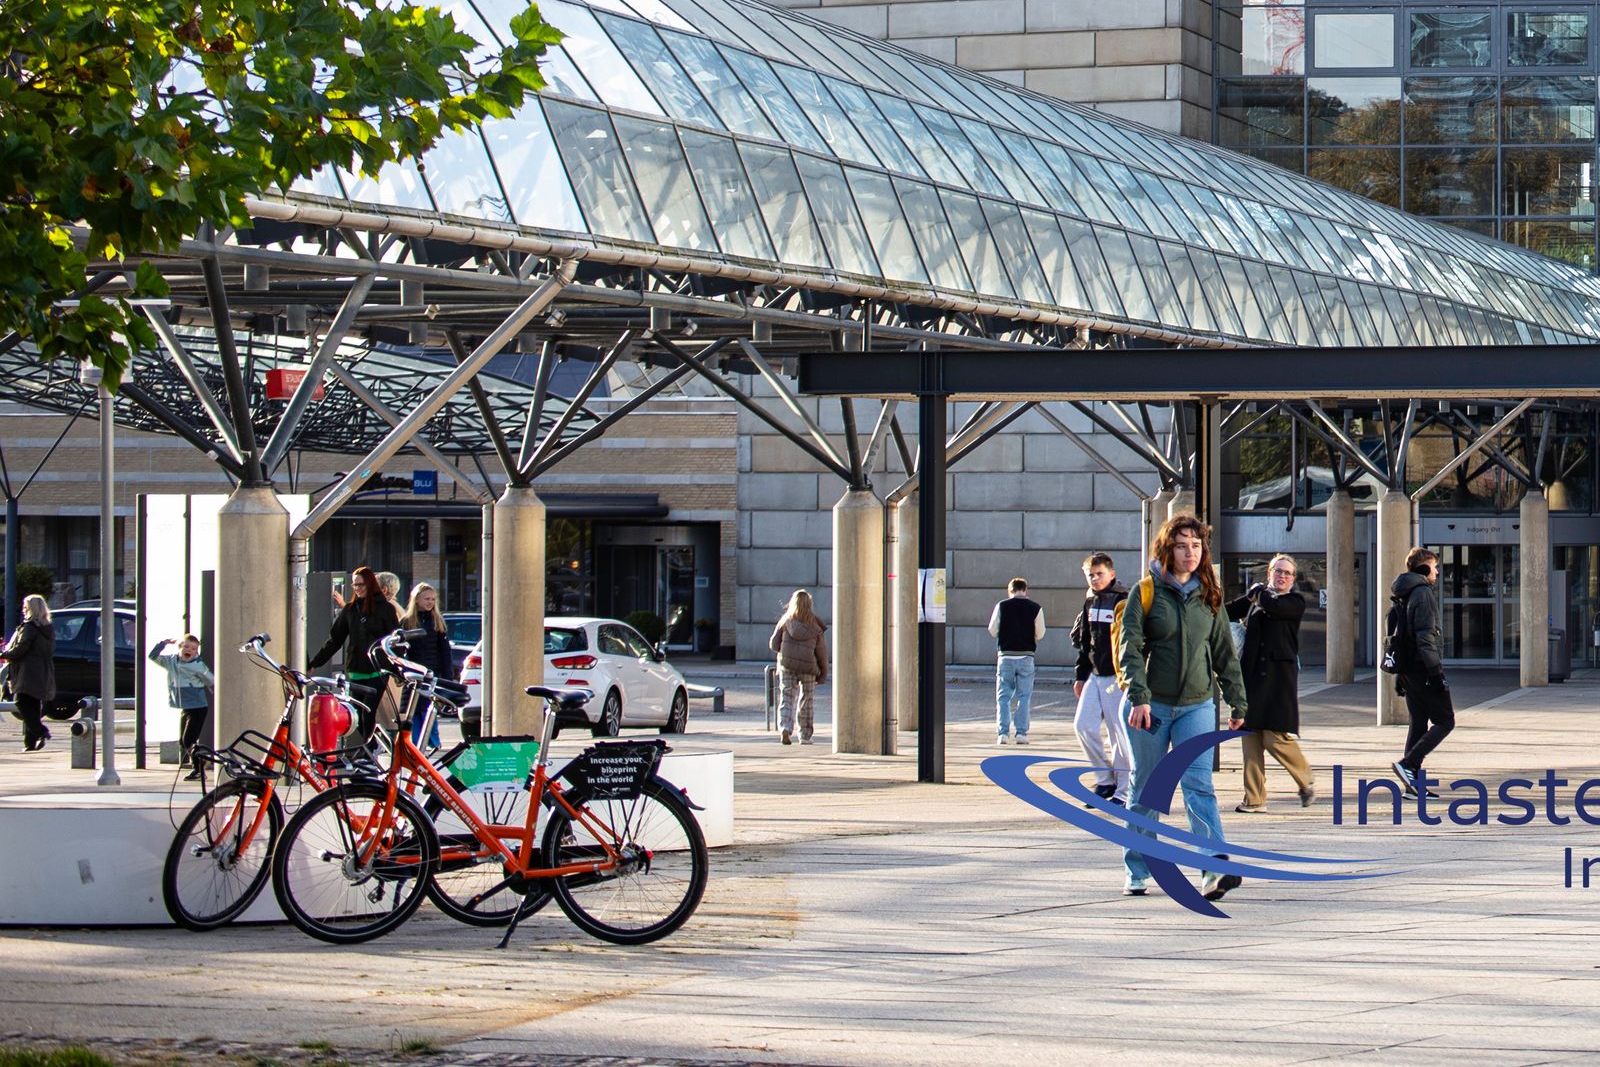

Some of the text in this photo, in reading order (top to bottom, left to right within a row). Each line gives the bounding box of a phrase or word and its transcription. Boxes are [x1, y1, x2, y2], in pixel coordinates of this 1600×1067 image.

[413, 479, 432, 488] BLU
[601, 766, 637, 774] bikeprint
[611, 775, 634, 783] world
[426, 775, 480, 832] DONKEY REPUBLIC
